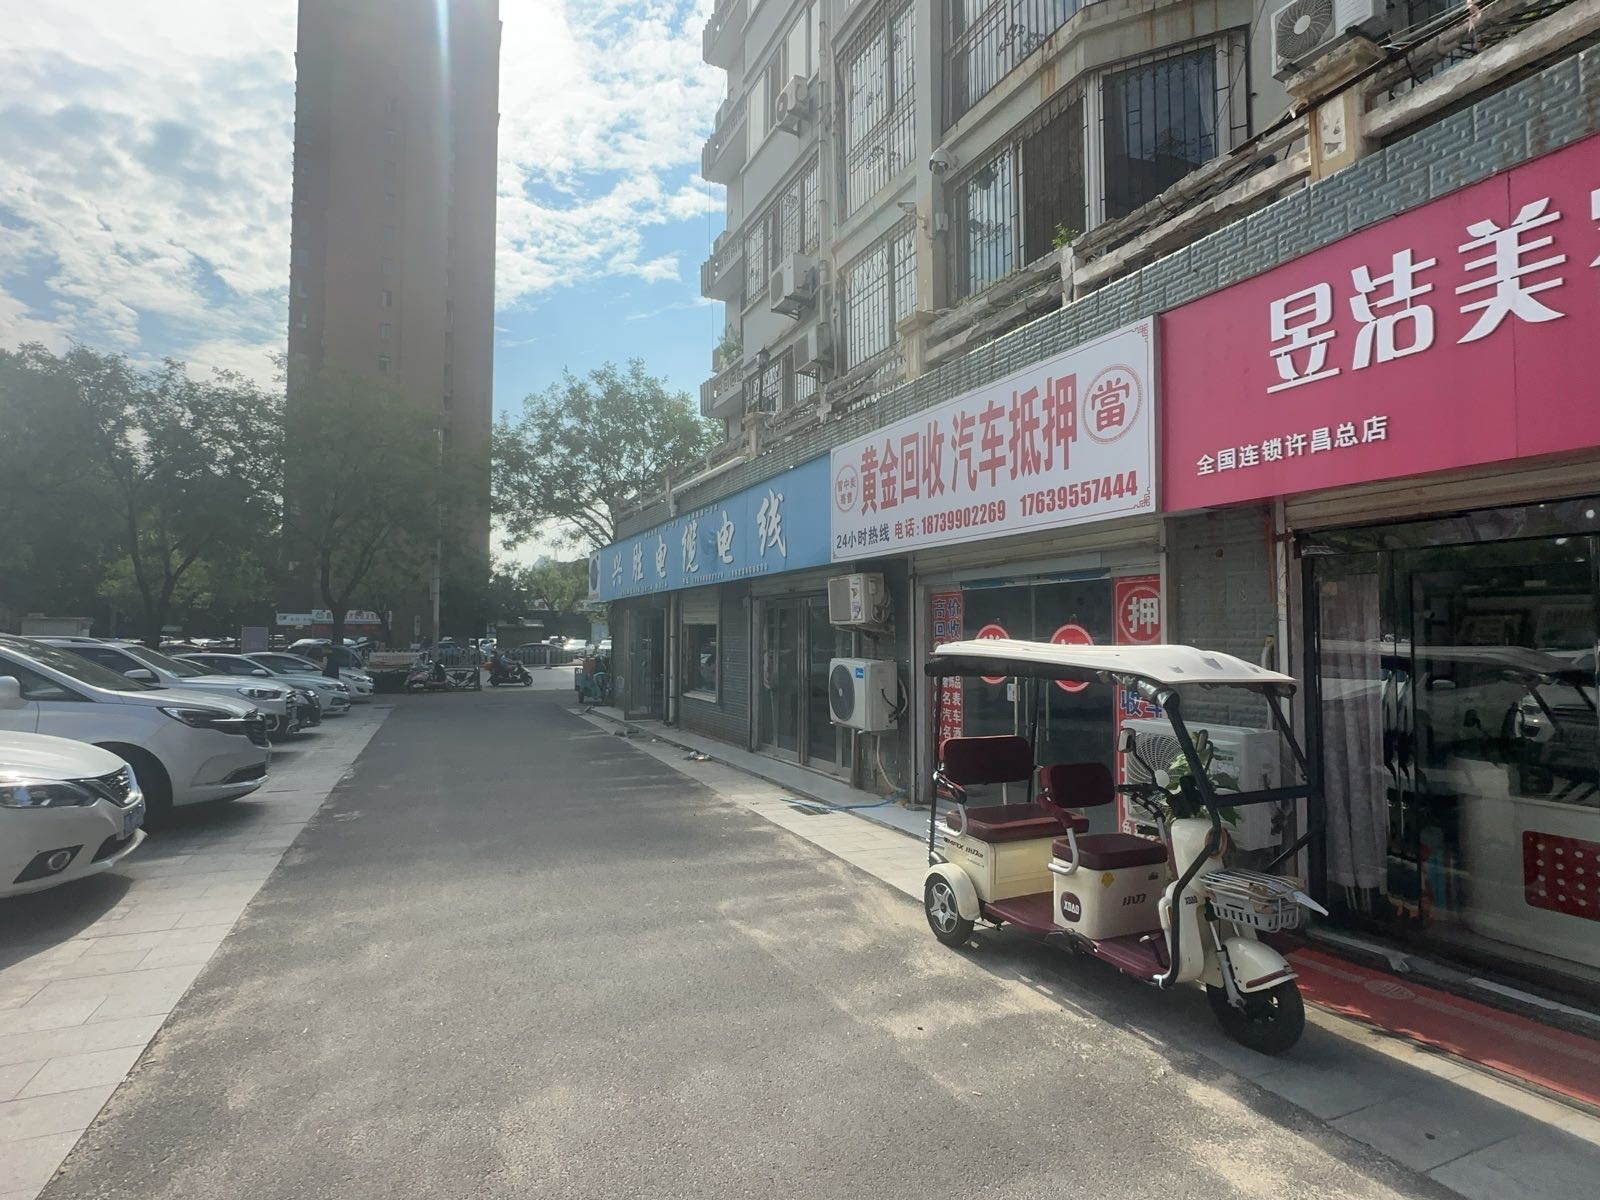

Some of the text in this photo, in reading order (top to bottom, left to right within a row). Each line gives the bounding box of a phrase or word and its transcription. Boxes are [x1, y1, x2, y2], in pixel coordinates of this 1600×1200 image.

[1267, 190, 1600, 393] 昱洁美
[1091, 377, 1130, 432] 當
[861, 373, 1077, 516] 黄金回收 汽车抵押
[1196, 415, 1388, 475] 全国连锁许昌总店
[836, 523, 890, 550] 24小时热线
[1020, 470, 1138, 516] 17639557444
[1127, 596, 1159, 635] 押
[942, 708, 961, 724] 汽车
